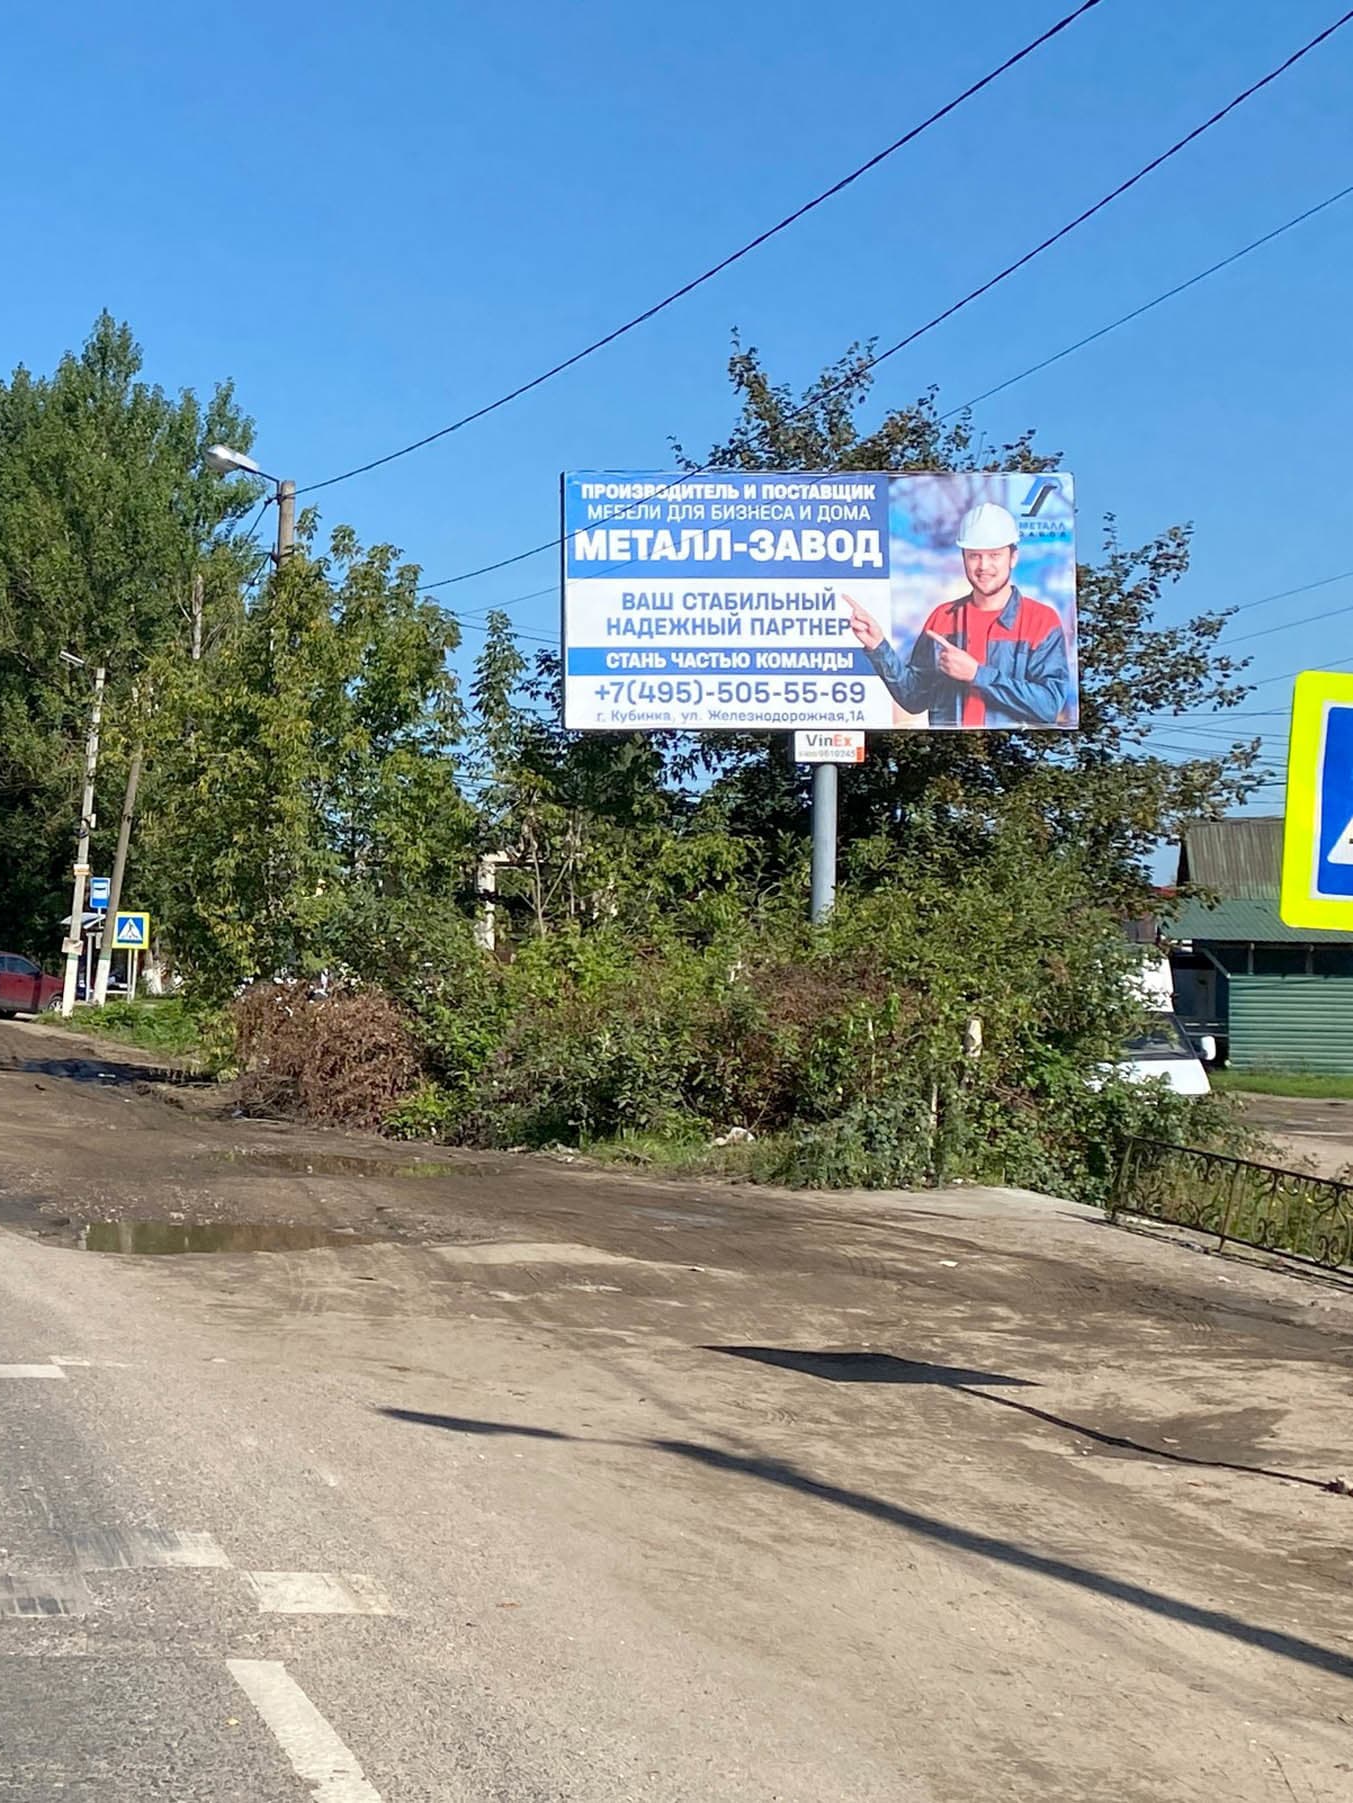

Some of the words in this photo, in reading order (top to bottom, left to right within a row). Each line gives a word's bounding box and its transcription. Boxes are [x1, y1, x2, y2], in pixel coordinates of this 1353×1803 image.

[581, 484, 740, 501] ПРОИЗВОДИТЕЛЬ
[744, 484, 757, 499] И
[761, 484, 876, 502] ПОСТАВЩИК
[587, 504, 661, 521] МЕБЕЛИ
[666, 504, 705, 523] ДЛЯ
[711, 504, 796, 521] БИЗНЕСА
[799, 504, 812, 521] И
[816, 504, 871, 523] ДОМА
[574, 528, 884, 568] МЕТАЛЛ-ЗАВОД
[621, 592, 674, 611] ВАШ
[682, 587, 836, 611] СТАБИЛЬНЫЙ
[606, 613, 742, 639] НАДЕЖНЫЙ
[750, 617, 851, 636] ПАРТНЕР
[606, 652, 667, 669] СТАНЬ
[671, 652, 751, 669] ЧАСТЬЮ
[756, 652, 854, 671] КОМАНДЫ
[594, 680, 866, 705] +7(495)-505-55-69
[681, 711, 703, 725] ул.
[805, 733, 853, 747] VinEx
